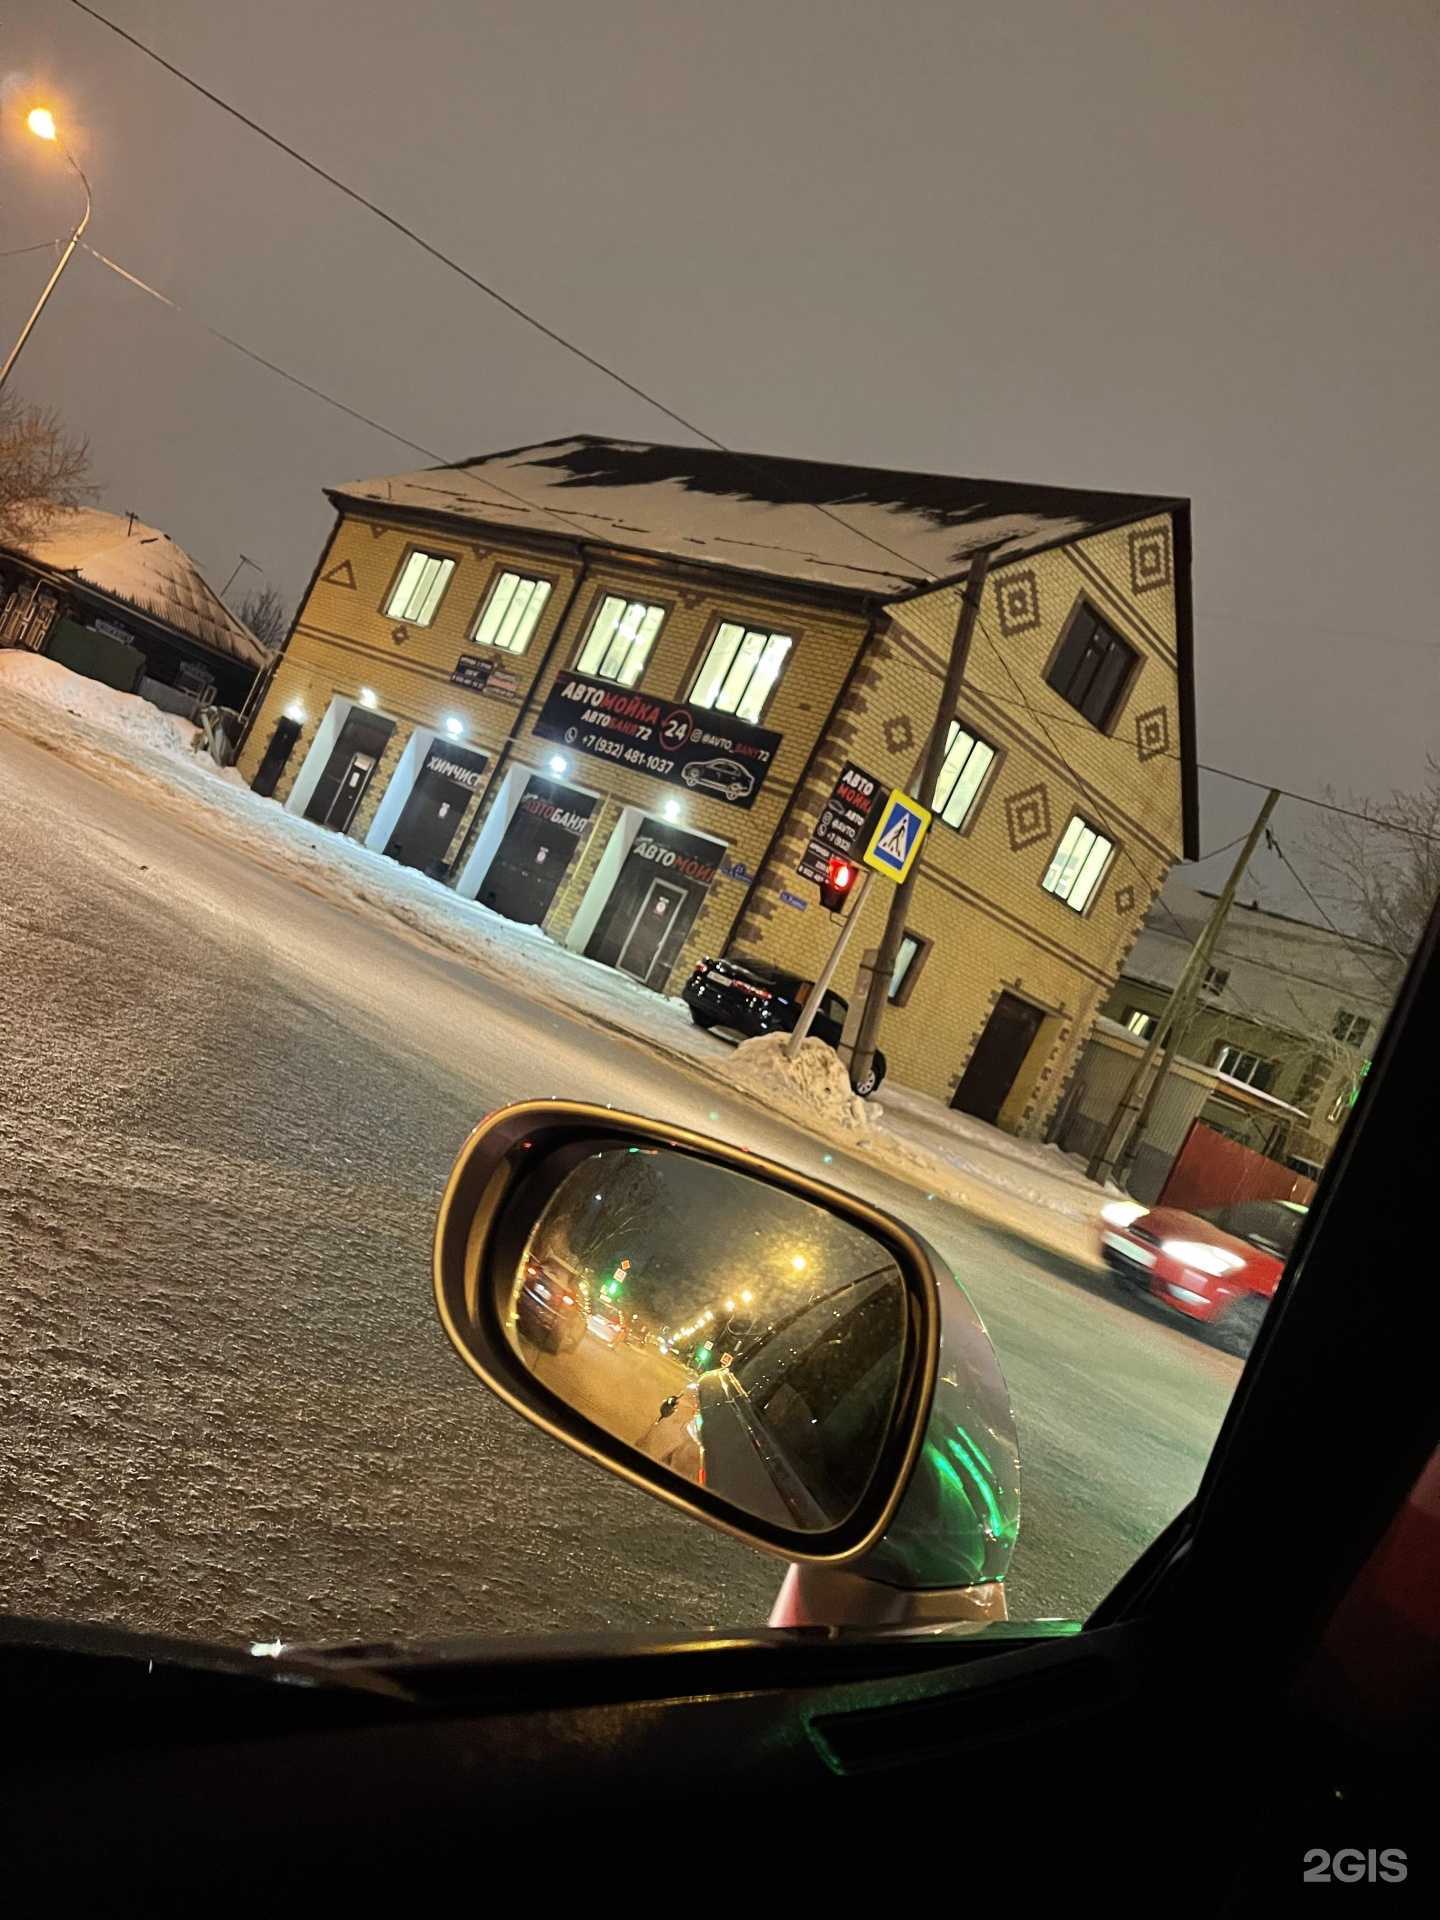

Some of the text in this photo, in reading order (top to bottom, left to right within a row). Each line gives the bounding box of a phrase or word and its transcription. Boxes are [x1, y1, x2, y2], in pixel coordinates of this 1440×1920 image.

[561, 681, 661, 725] АВТОМОЙКА
[663, 720, 688, 741] 24
[582, 735, 674, 774] +7 (932) 481-1037
[842, 769, 874, 796] АВТО
